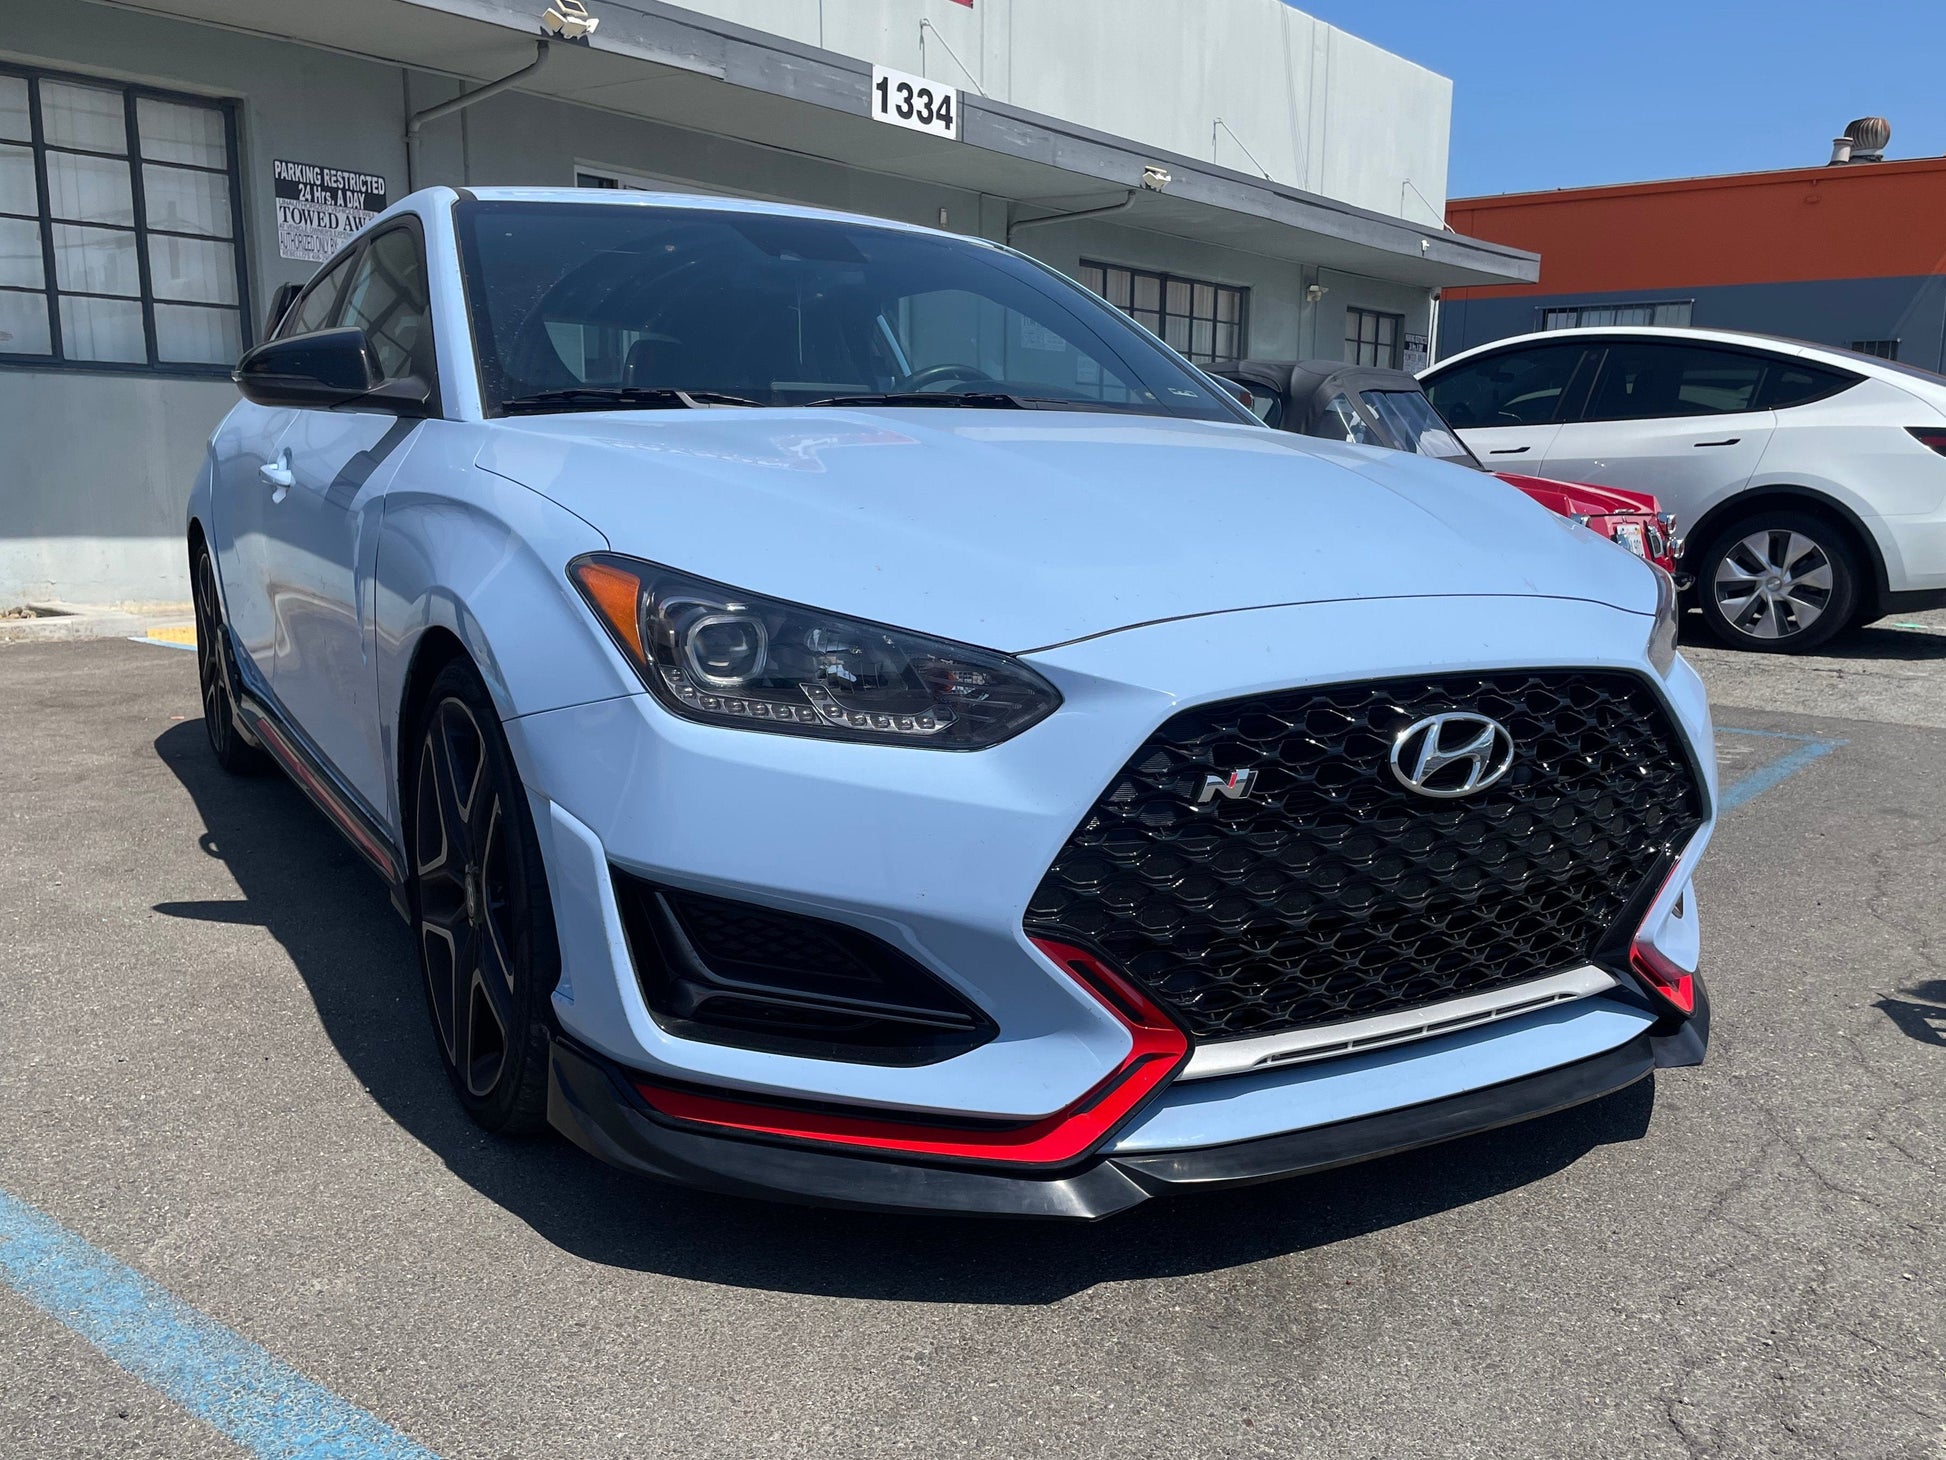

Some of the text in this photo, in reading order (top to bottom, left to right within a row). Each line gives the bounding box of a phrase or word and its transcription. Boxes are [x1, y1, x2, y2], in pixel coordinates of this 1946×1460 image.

[875, 76, 953, 130] 1334
[274, 160, 385, 195] PARKING RESTRICTED
[298, 183, 365, 210] 24 Hrs. A DAY
[280, 206, 371, 231] TOWED AW
[280, 231, 315, 252] AUTHORIZED
[316, 236, 331, 254] ONLY
